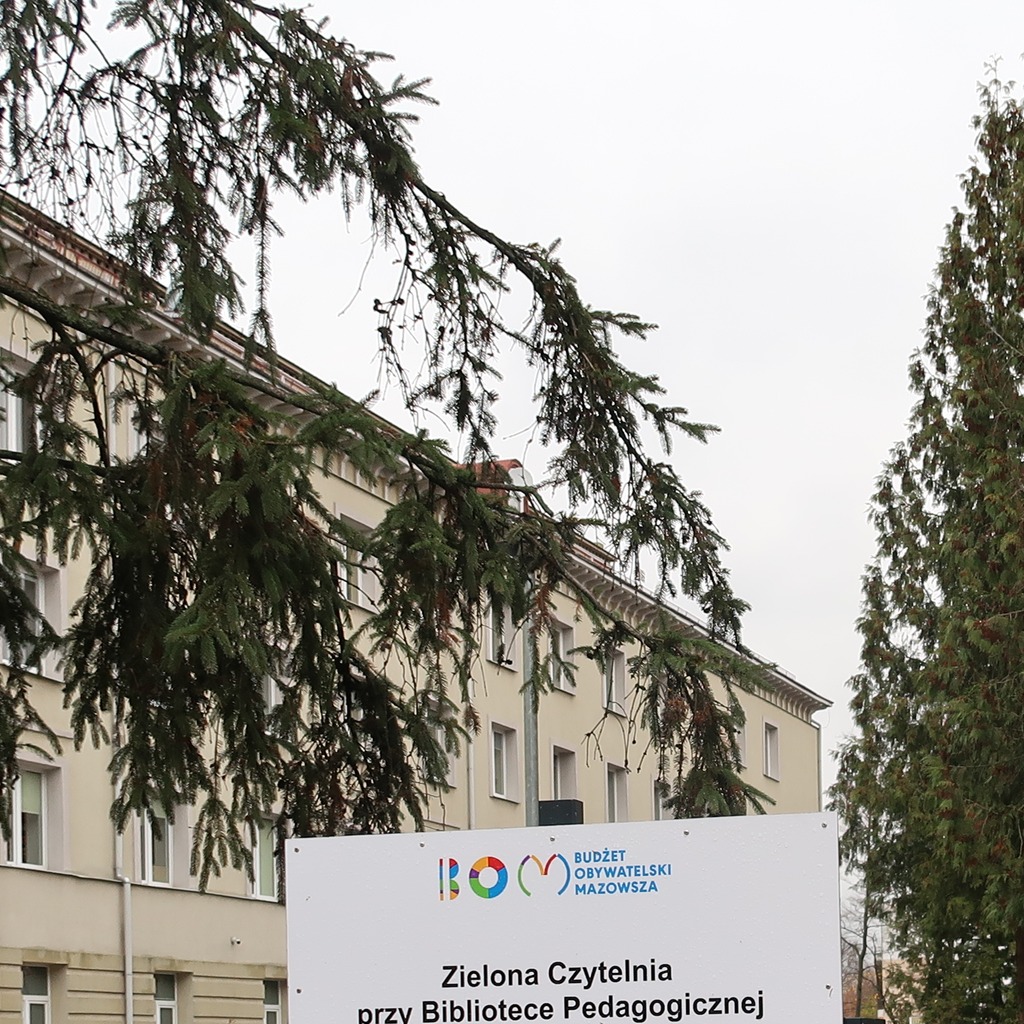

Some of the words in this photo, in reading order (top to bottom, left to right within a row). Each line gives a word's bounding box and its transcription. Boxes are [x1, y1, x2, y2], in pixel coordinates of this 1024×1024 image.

[575, 848, 626, 863] BUDŻET
[575, 864, 671, 879] OBYWATELSKI
[575, 881, 658, 895] MAZOWSZA
[442, 964, 538, 988] Zielona
[548, 959, 672, 990] Czytelnia
[422, 999, 553, 1023] Bibliotece
[564, 990, 763, 1024] Pedagogicznej
